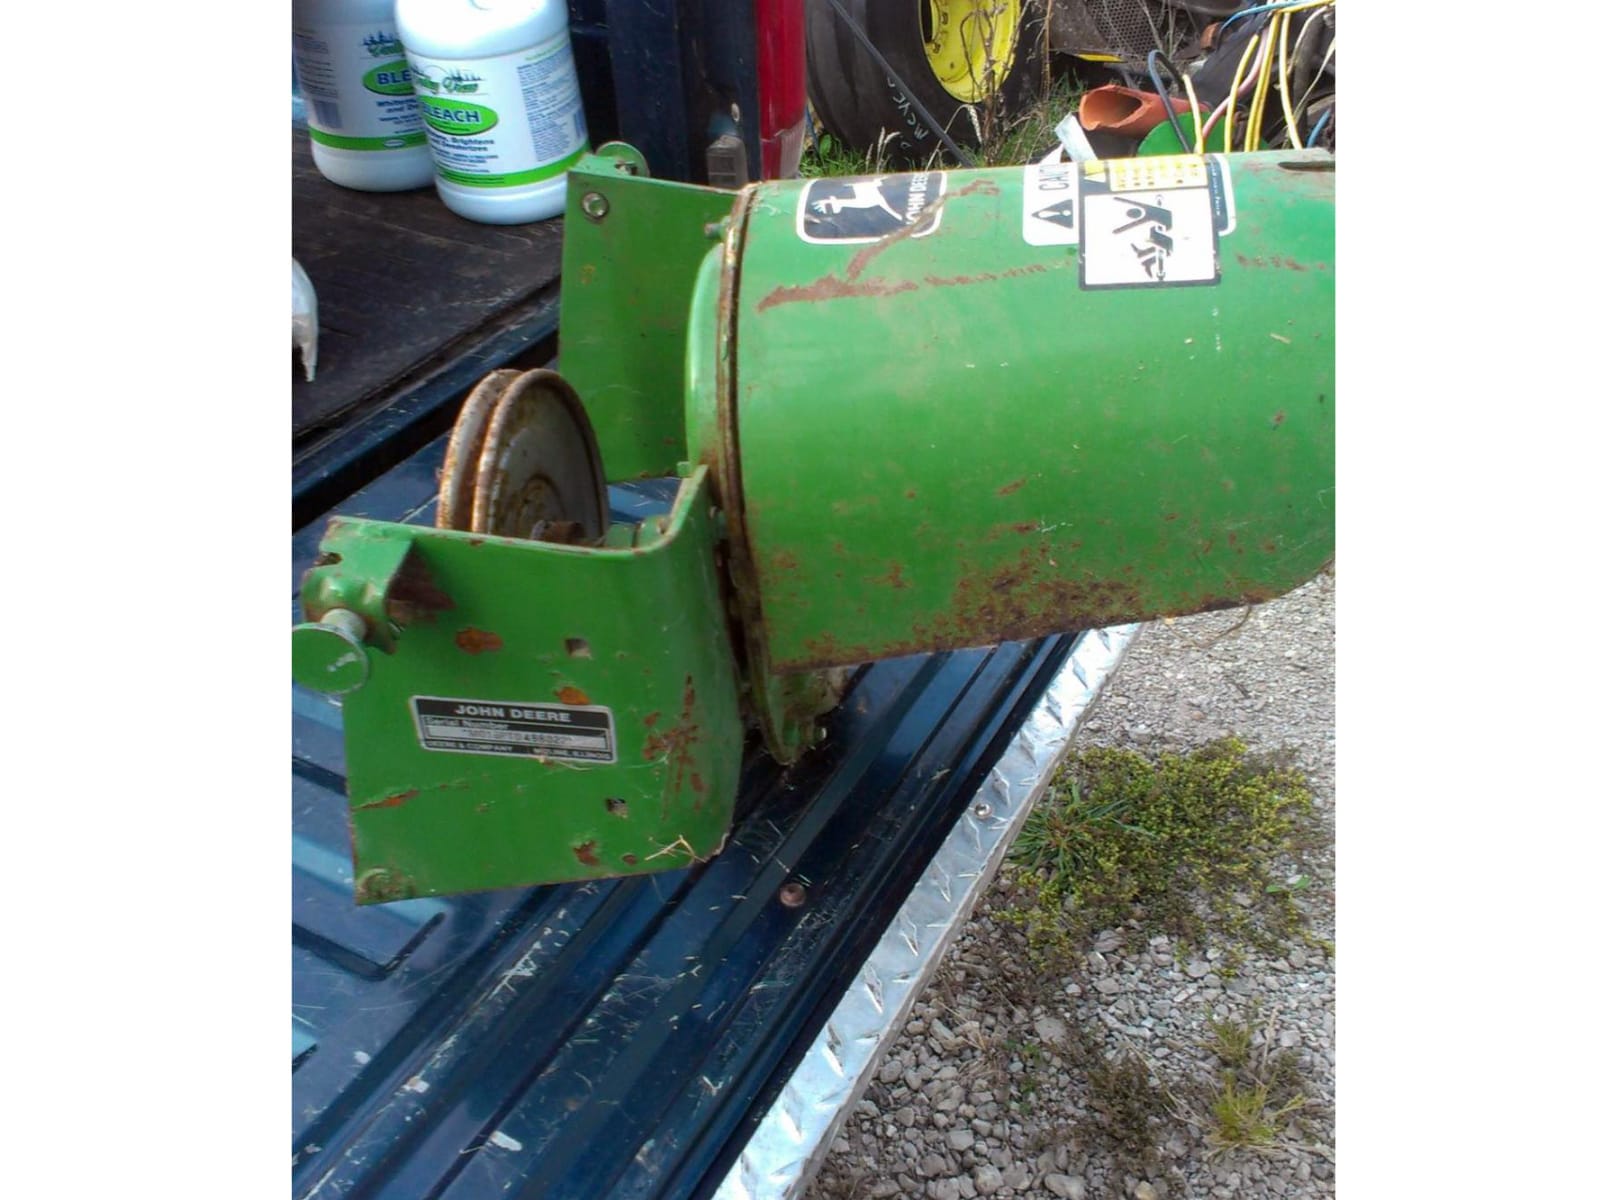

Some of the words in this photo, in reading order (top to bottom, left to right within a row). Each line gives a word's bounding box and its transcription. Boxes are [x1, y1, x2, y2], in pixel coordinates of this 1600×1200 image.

[455, 704, 505, 719] JOHN
[510, 708, 572, 723] DEERE
[463, 719, 509, 730] Number
